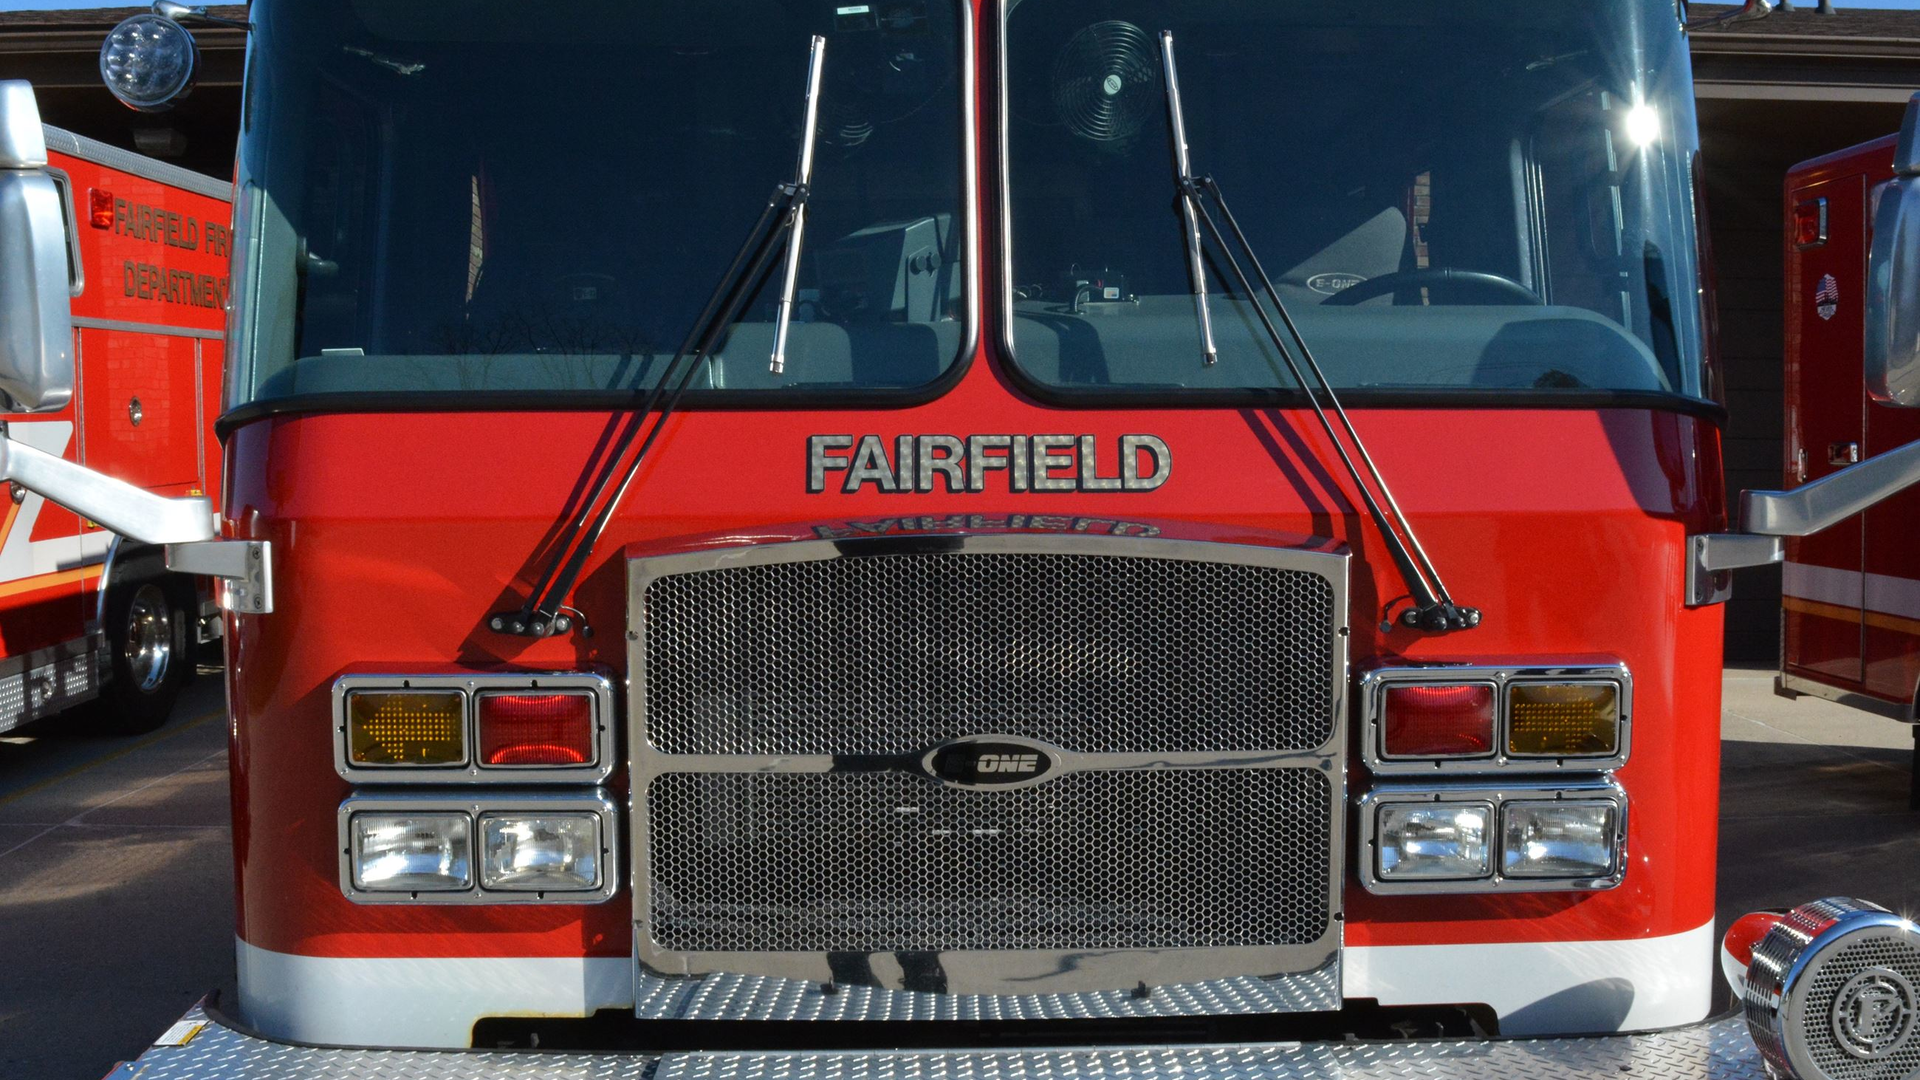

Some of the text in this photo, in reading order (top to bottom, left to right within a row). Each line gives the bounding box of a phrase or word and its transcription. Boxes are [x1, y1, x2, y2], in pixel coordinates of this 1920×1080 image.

[115, 198, 231, 257] FAIRFIELD FIR
[805, 434, 1172, 493] FAIRFIELD
[944, 754, 1038, 773] -ONE
